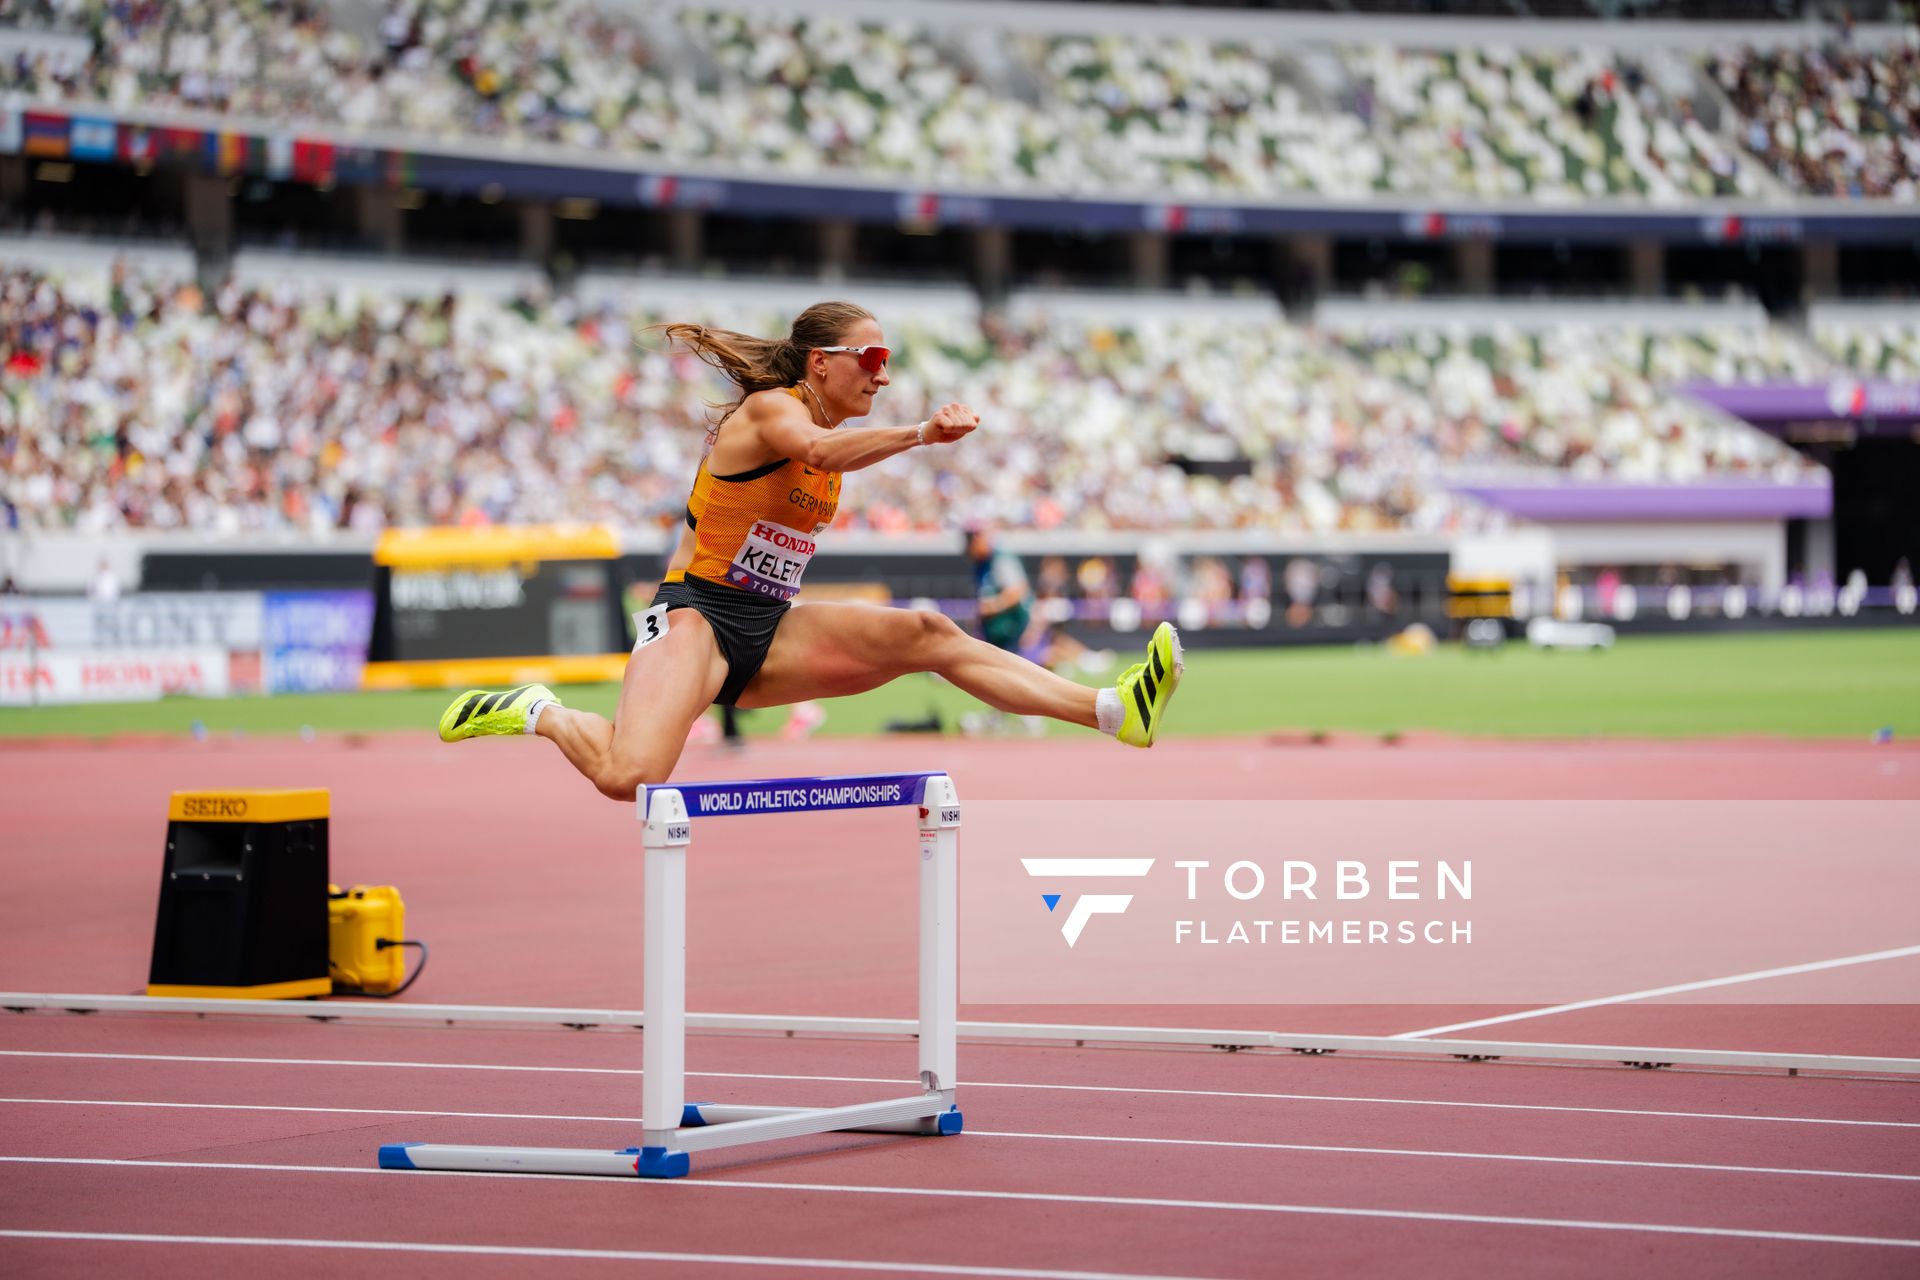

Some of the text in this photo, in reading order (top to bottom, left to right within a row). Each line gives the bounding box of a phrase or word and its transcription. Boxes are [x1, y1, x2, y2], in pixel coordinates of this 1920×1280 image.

[752, 523, 816, 555] HONDA
[642, 615, 659, 643] 3
[183, 797, 248, 817] SEIKO
[700, 784, 900, 812] WORLD ATHLETICS CHAMPIONSHIPS
[941, 810, 960, 822] NISHI
[667, 827, 690, 840] NISHI
